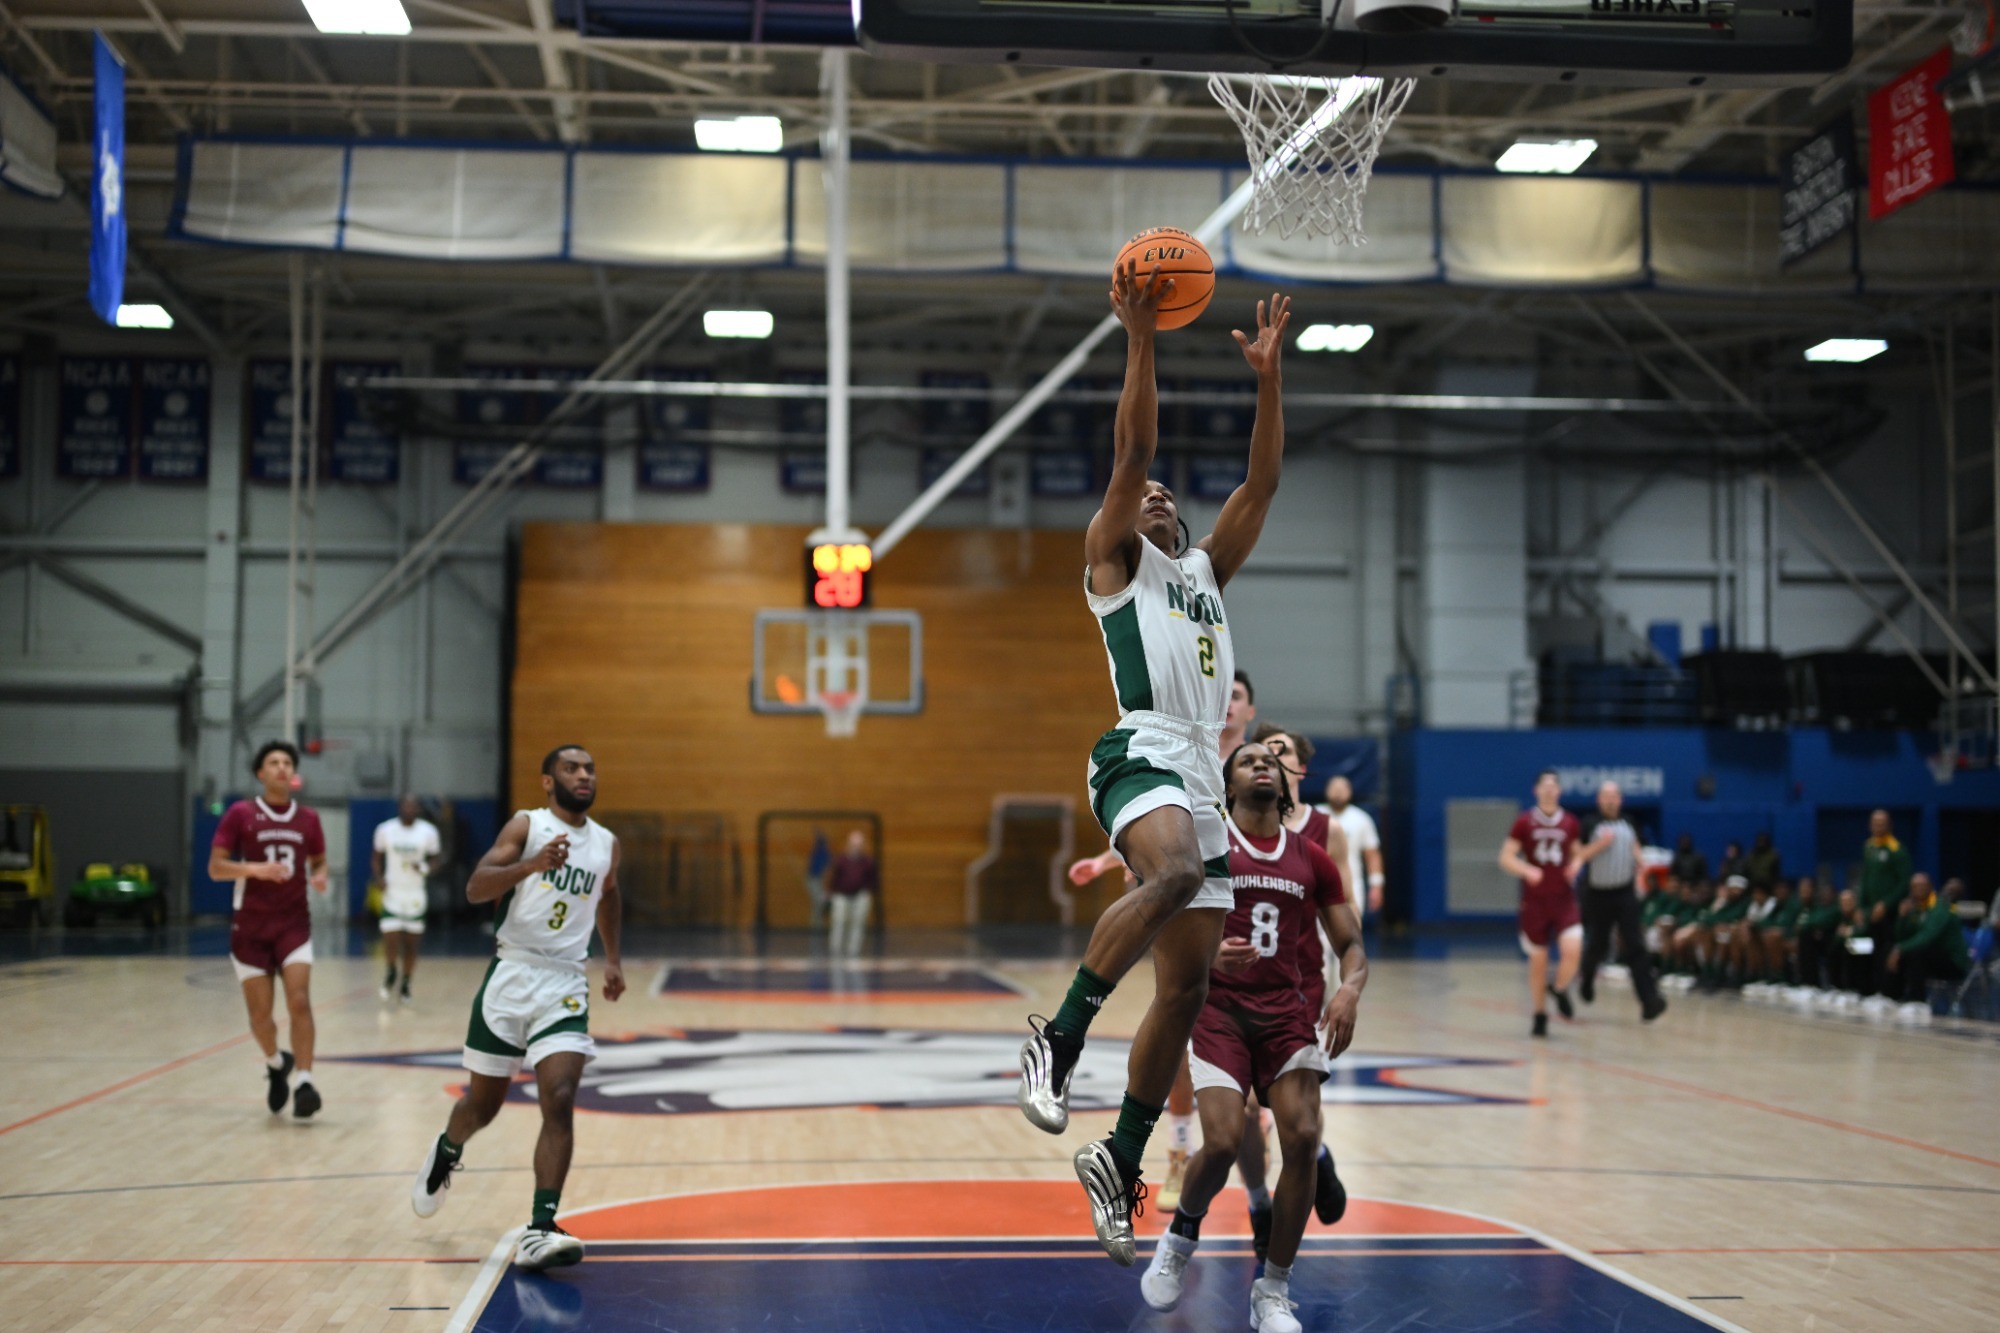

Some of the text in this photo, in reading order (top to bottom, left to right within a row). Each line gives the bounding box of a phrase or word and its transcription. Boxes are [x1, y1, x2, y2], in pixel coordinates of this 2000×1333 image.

[1144, 247, 1185, 262] EVO
[64, 360, 131, 386] NCAA
[143, 361, 208, 387] NCAA
[1197, 634, 1215, 679] 2
[263, 844, 295, 881] 13
[1534, 840, 1563, 865] 44
[542, 863, 597, 895] NJCU
[1231, 875, 1305, 900] MUHLENBERG
[548, 900, 568, 931] 3
[1251, 901, 1279, 957] 8
